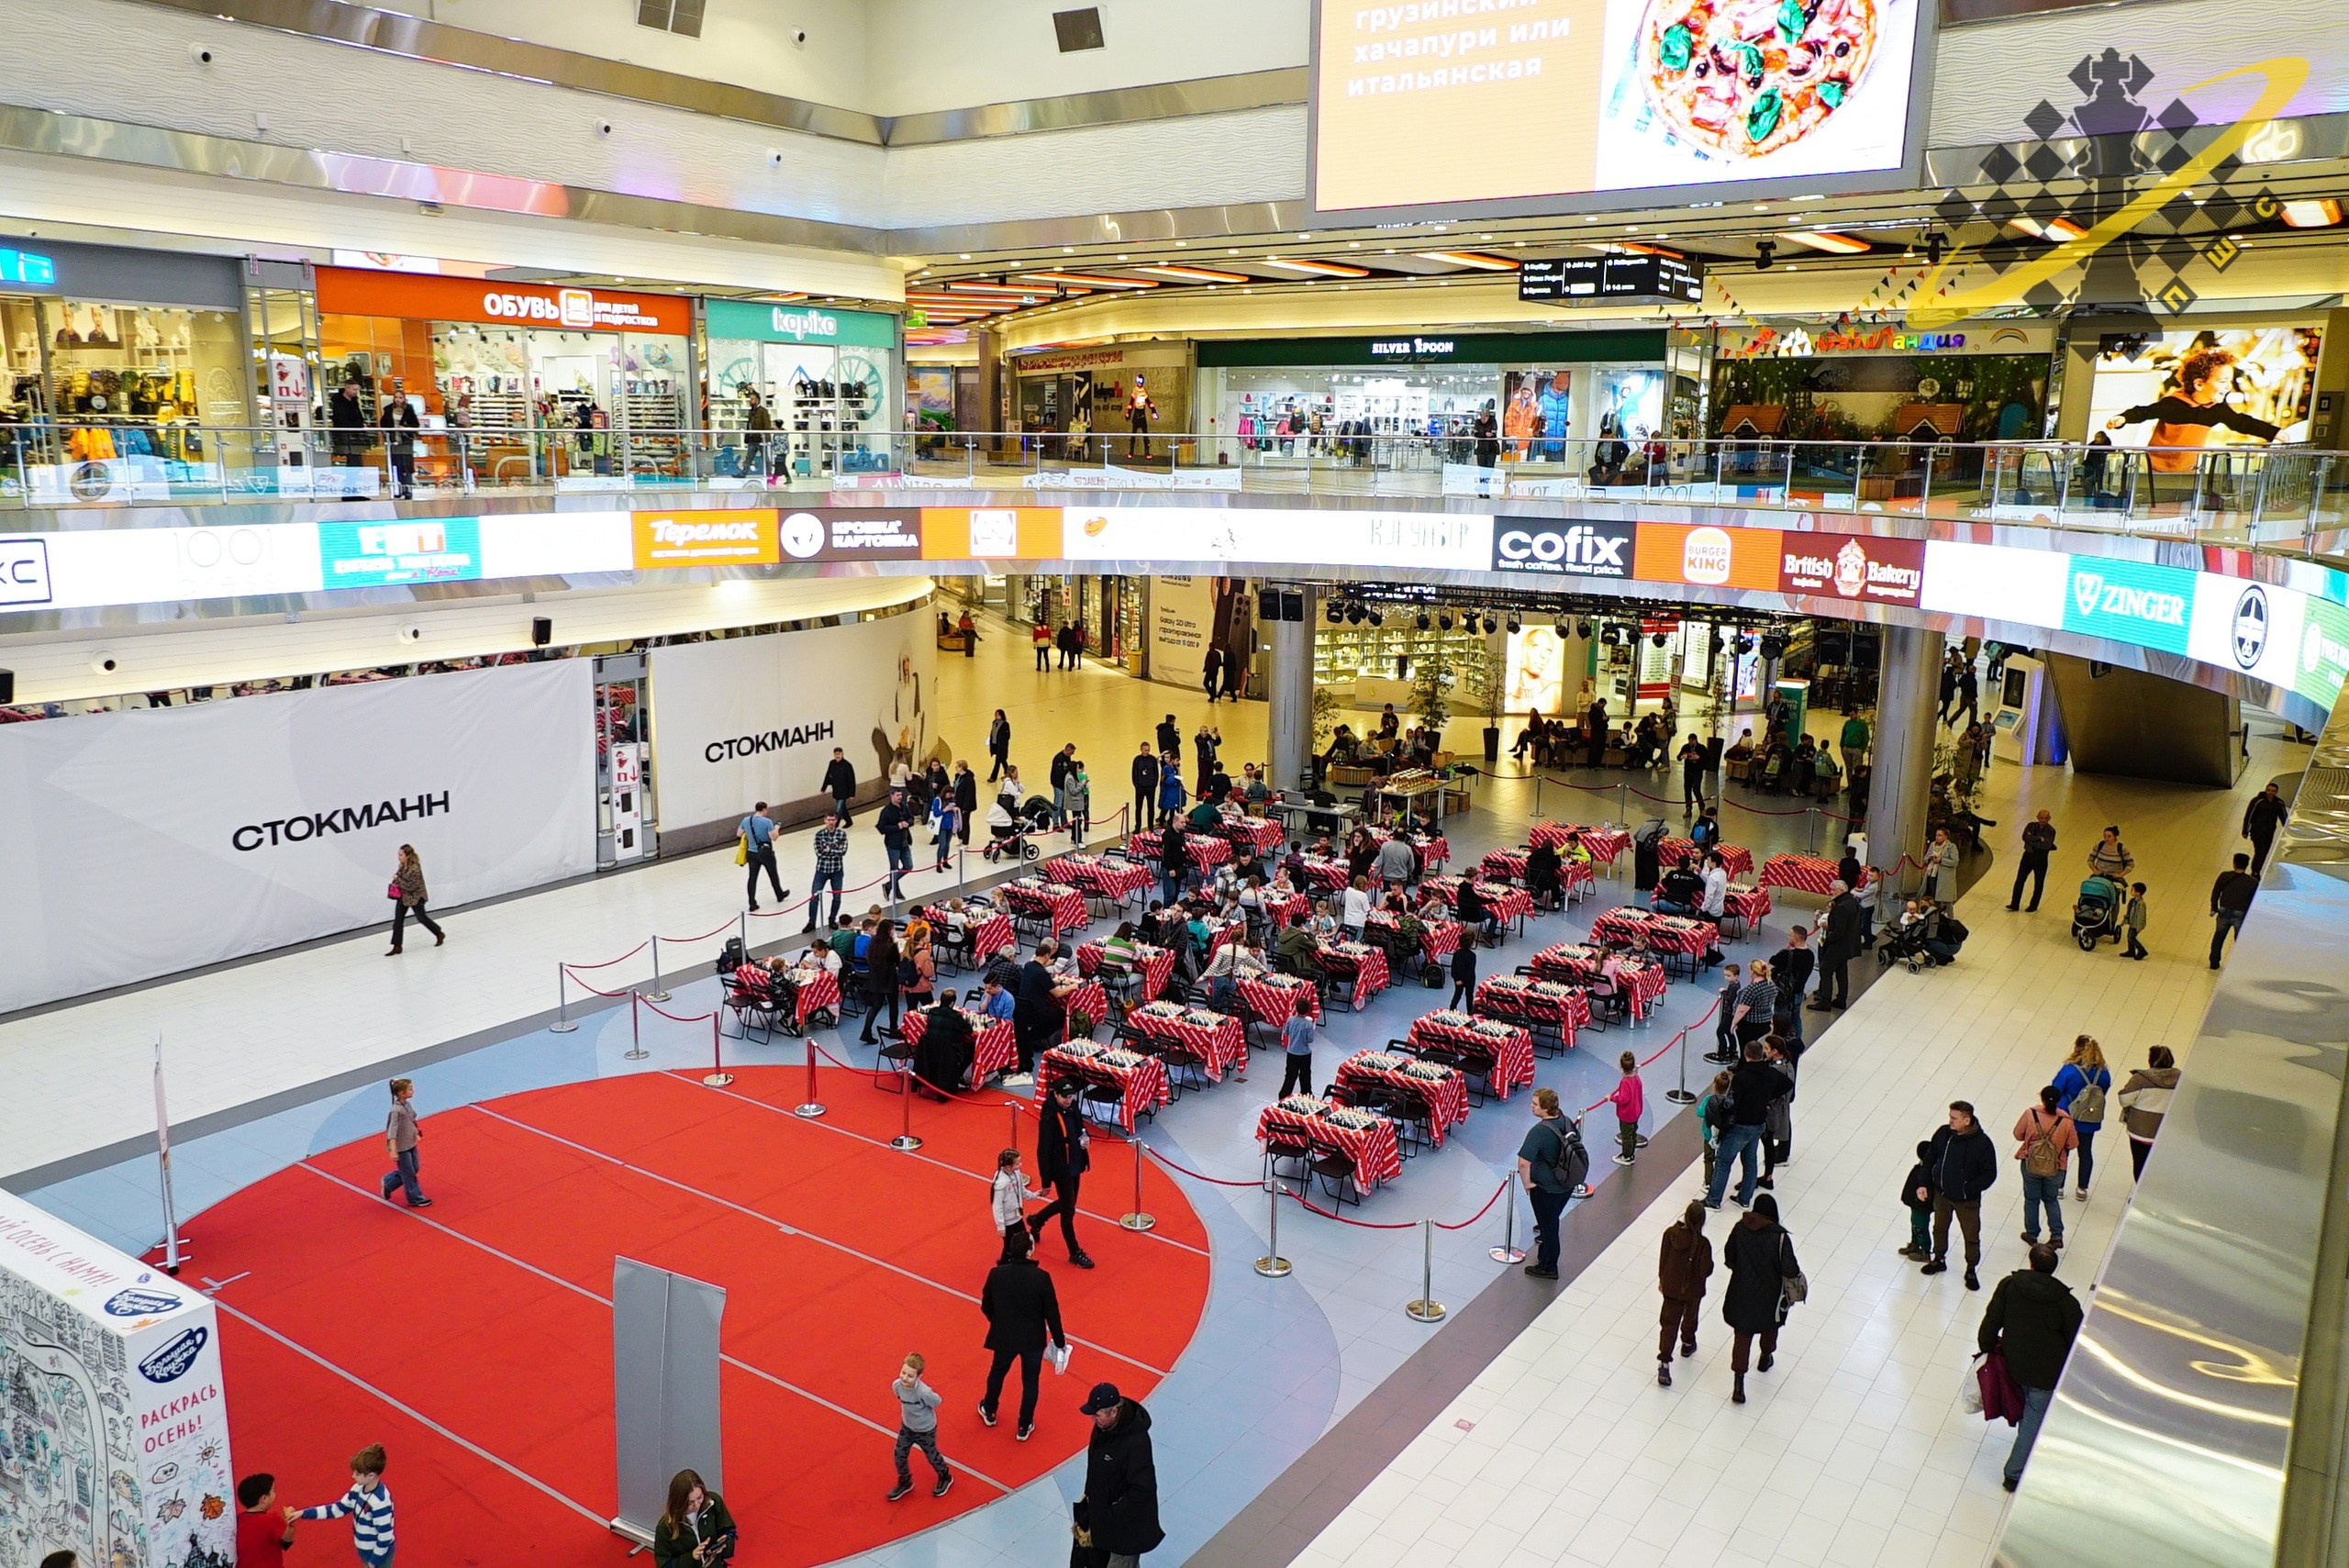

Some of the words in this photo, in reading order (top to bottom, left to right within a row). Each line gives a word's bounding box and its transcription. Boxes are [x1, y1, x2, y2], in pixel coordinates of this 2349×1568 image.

[1353, 28, 1497, 63] хачапури
[1509, 18, 1571, 44] или
[1348, 57, 1542, 96] итальянская
[484, 294, 560, 320] ОБУВЬ
[773, 307, 837, 340] kapika
[1372, 343, 1410, 354] SILVER
[1414, 338, 1453, 353] SPOON
[650, 519, 759, 547] Теремок
[1499, 526, 1623, 565] cofix
[1688, 545, 1727, 557] BURGER
[1687, 556, 1726, 572] KING
[1784, 554, 1833, 579] British
[1866, 561, 1920, 589] Bakery
[2100, 584, 2185, 626] ZINGER
[705, 720, 834, 763] СТОКМАНН
[232, 790, 451, 851] СТОКМАНН
[6, 1229, 60, 1255] ОСЕНЬ
[145, 1339, 195, 1376] Большая
[141, 1384, 217, 1429] РАСКРАСЬ
[145, 1414, 203, 1453] ОСЕНЬ!
